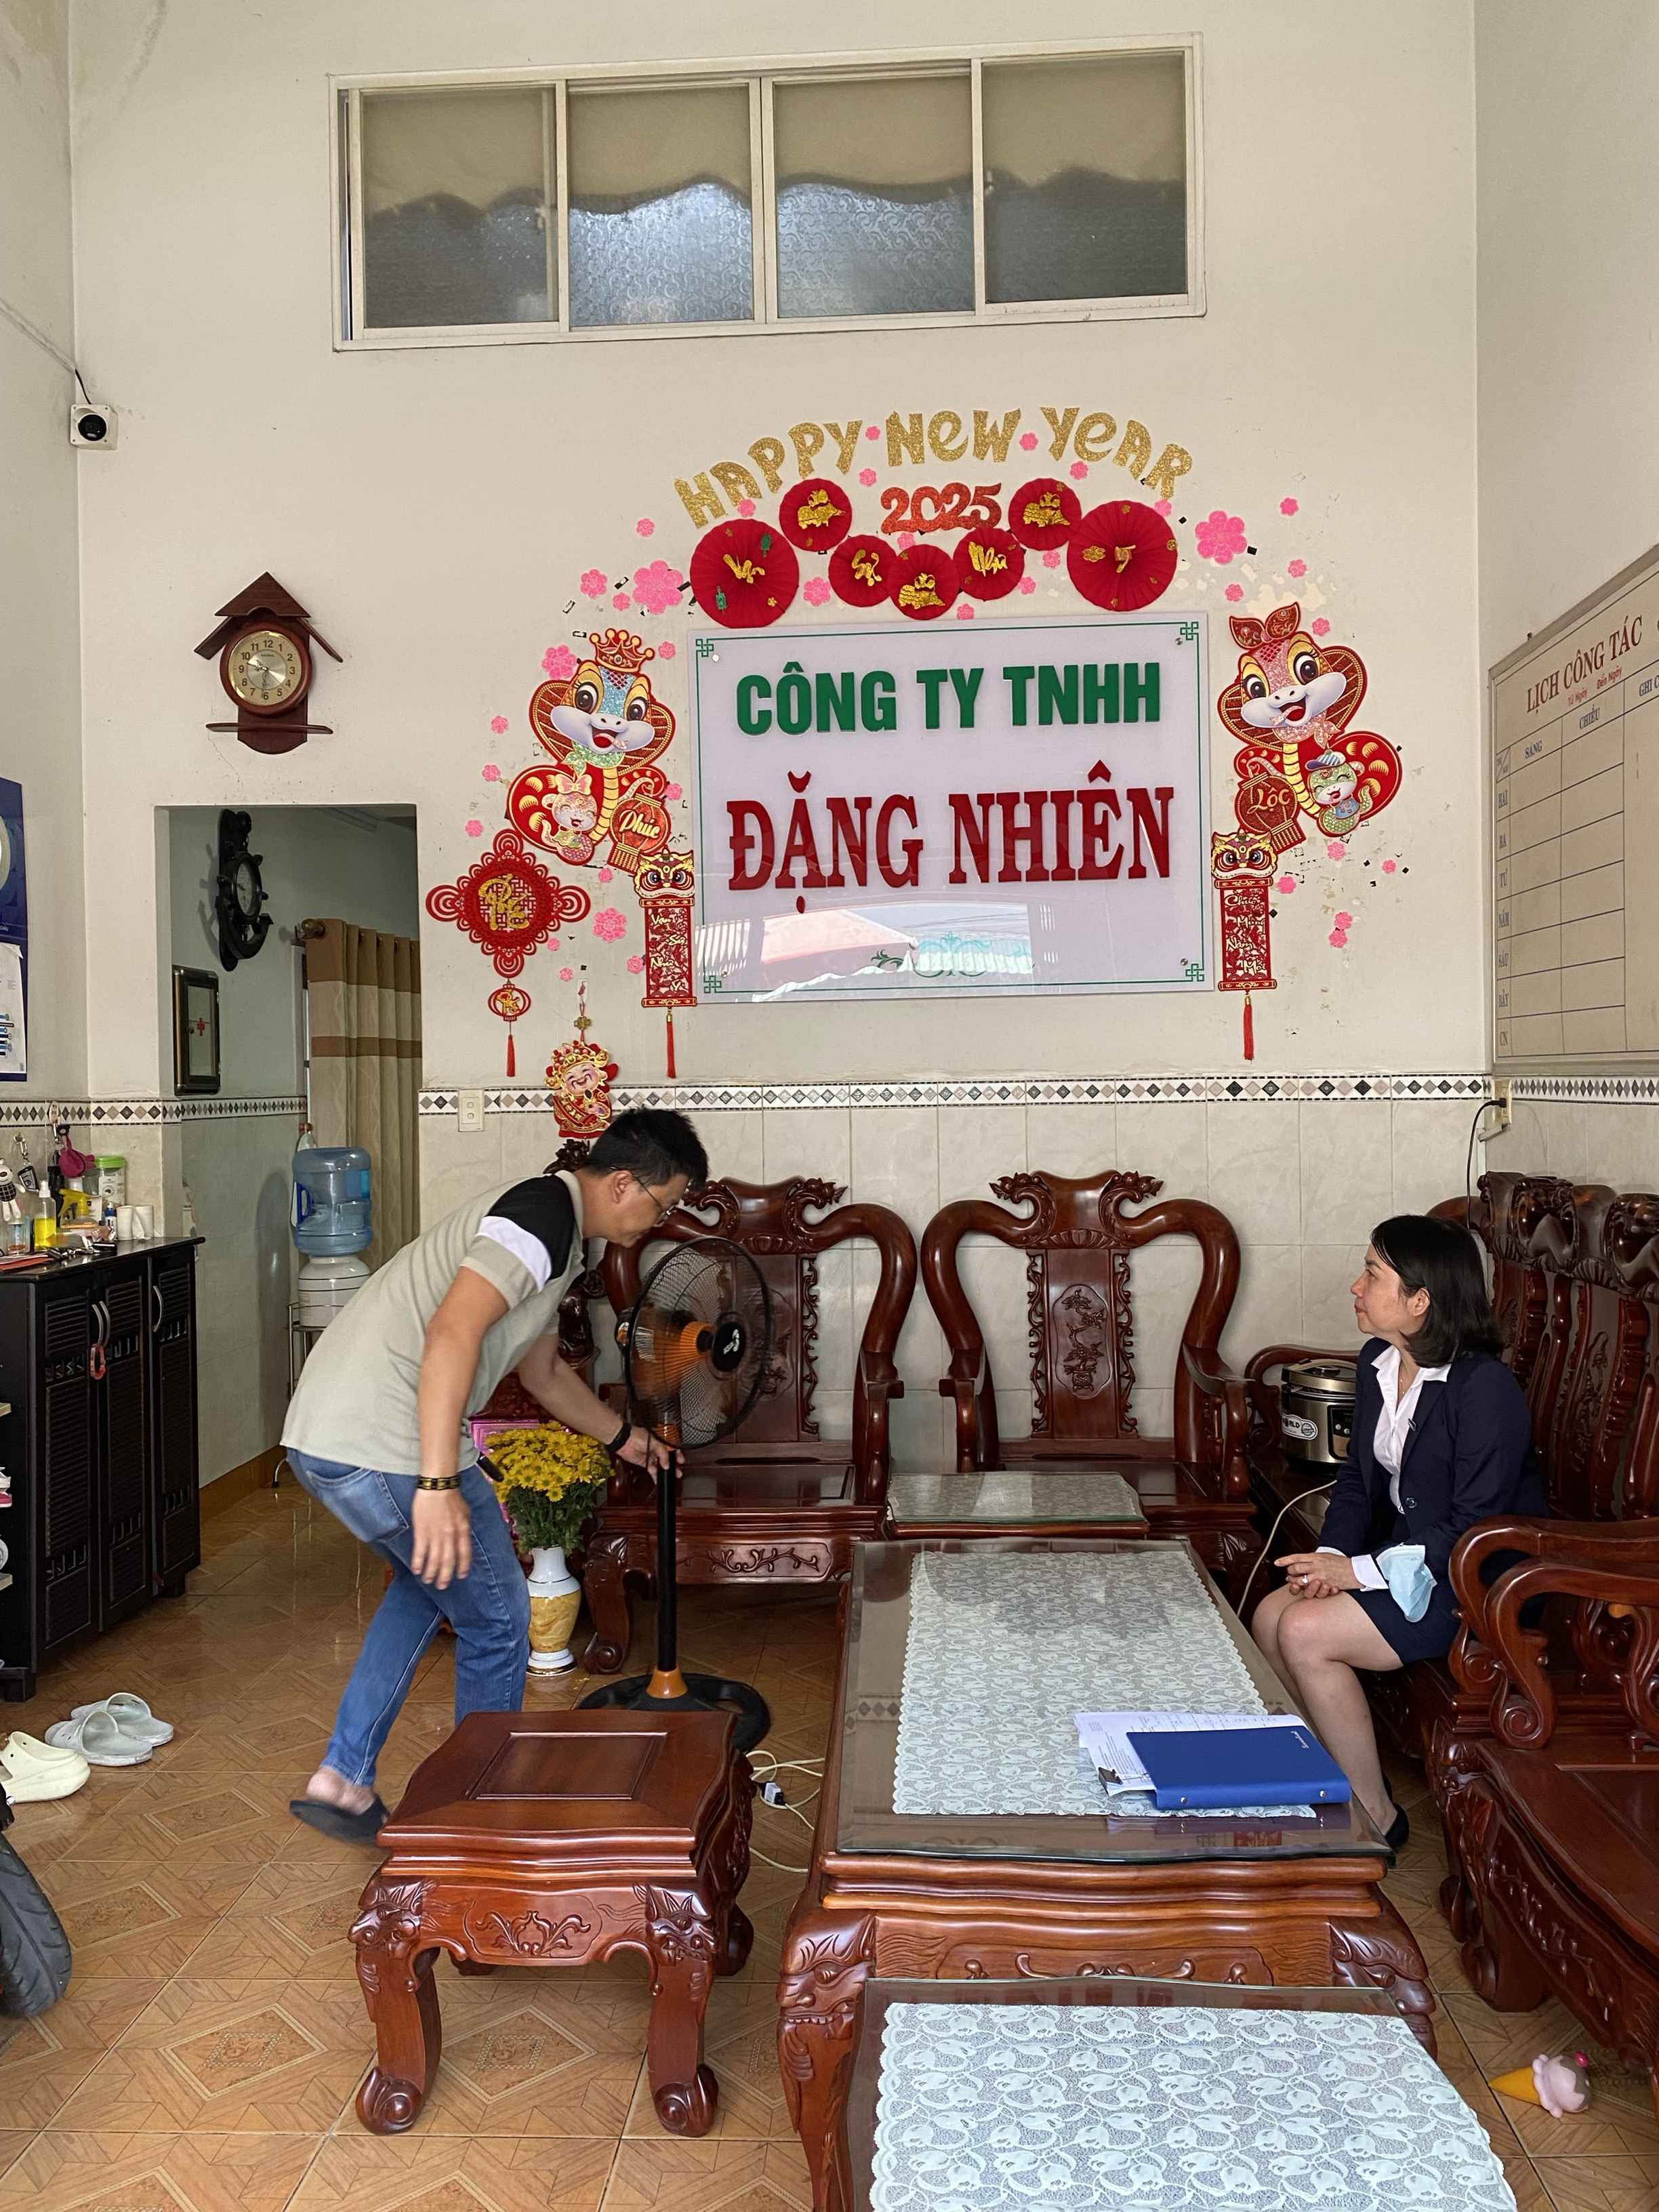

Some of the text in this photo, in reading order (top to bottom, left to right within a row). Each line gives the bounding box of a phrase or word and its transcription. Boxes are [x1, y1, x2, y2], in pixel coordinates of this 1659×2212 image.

[675, 419, 863, 529] HAPPY
[880, 483, 1002, 533] 2025
[250, 642, 259, 651] 11
[263, 640, 273, 648] 12
[278, 643, 282, 652] 1
[241, 652, 251, 660] 10
[287, 653, 293, 661] 2
[238, 665, 244, 673] 9
[1527, 615, 1643, 714] LỊCH CÔNG TÁC
[289, 666, 295, 674] 3
[241, 678, 247, 687] 8
[285, 679, 291, 687] 4
[250, 688, 255, 696] 7
[1639, 678, 1653, 697] GHI
[263, 692, 269, 700] 6
[276, 689, 283, 697] 5
[736, 661, 1160, 735] CÔNG TY TNHH
[618, 809, 661, 840] Phúc
[726, 760, 1174, 914] ĐẶNG NHIÊN
